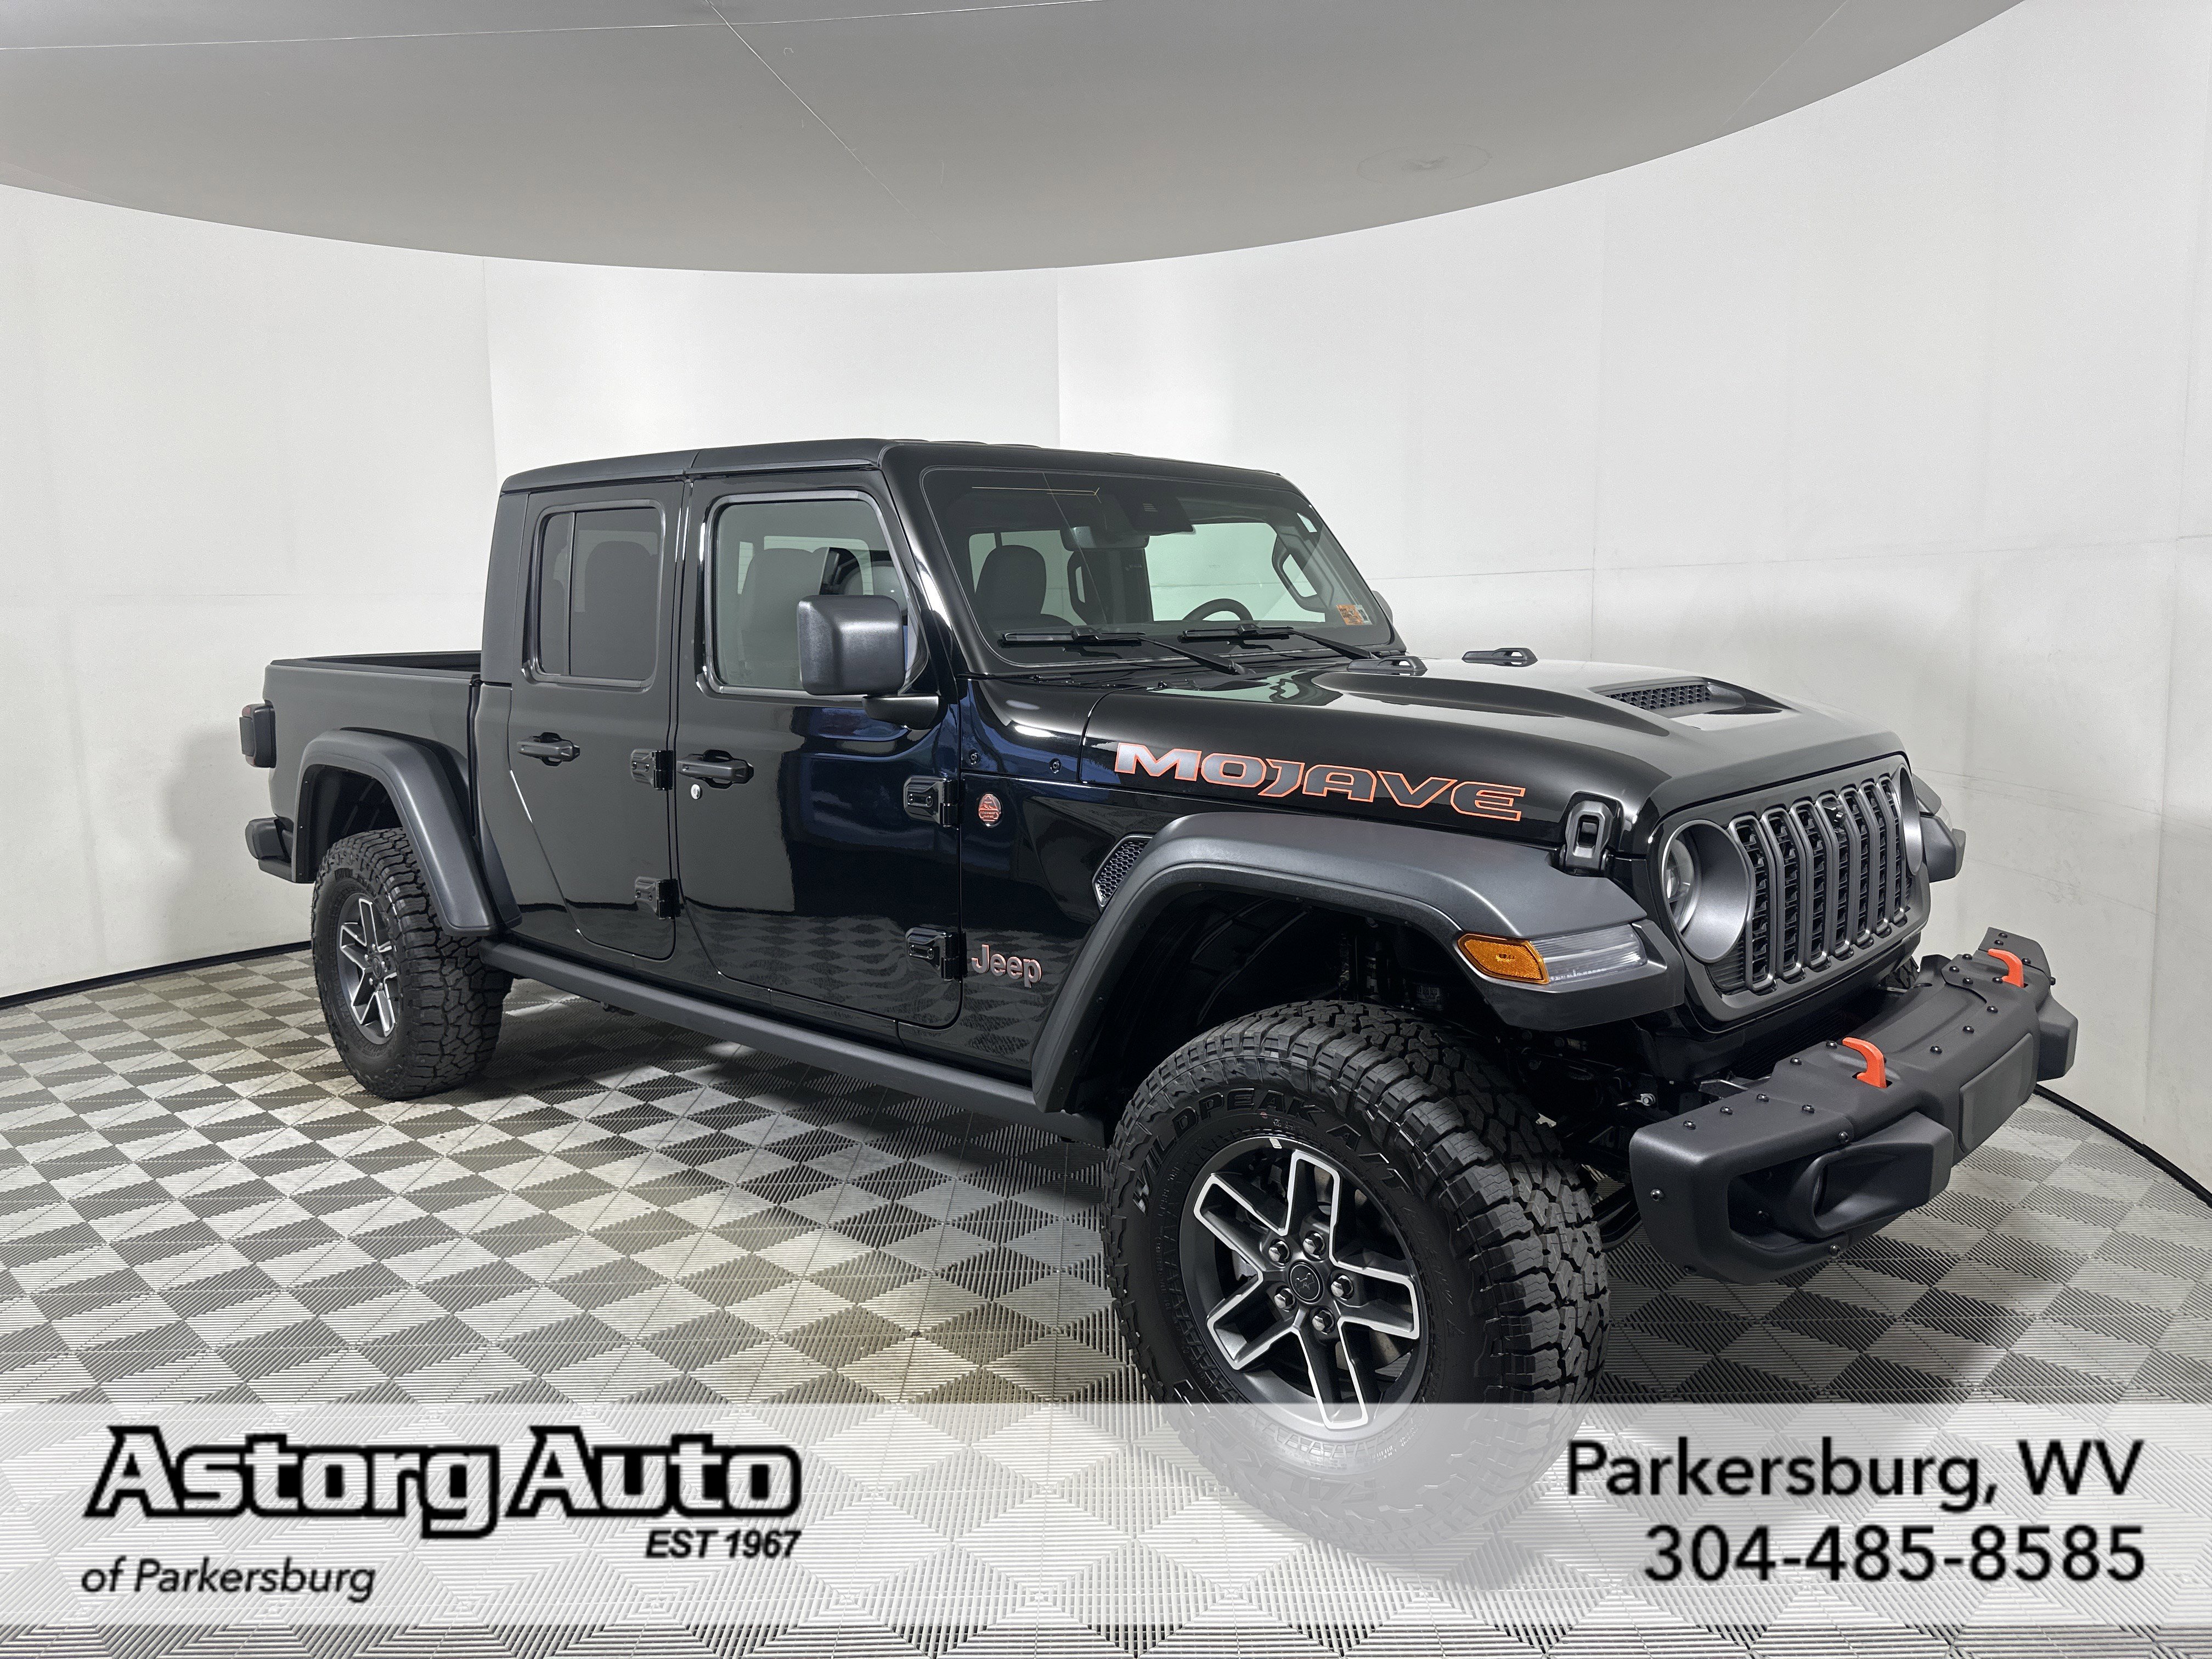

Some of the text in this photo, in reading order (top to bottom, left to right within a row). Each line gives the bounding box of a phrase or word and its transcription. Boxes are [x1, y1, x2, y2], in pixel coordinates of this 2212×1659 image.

[1114, 742, 1526, 821] MOJAVE
[971, 944, 1041, 988] Jeep
[1133, 1087, 1326, 1216] WILDPEAK
